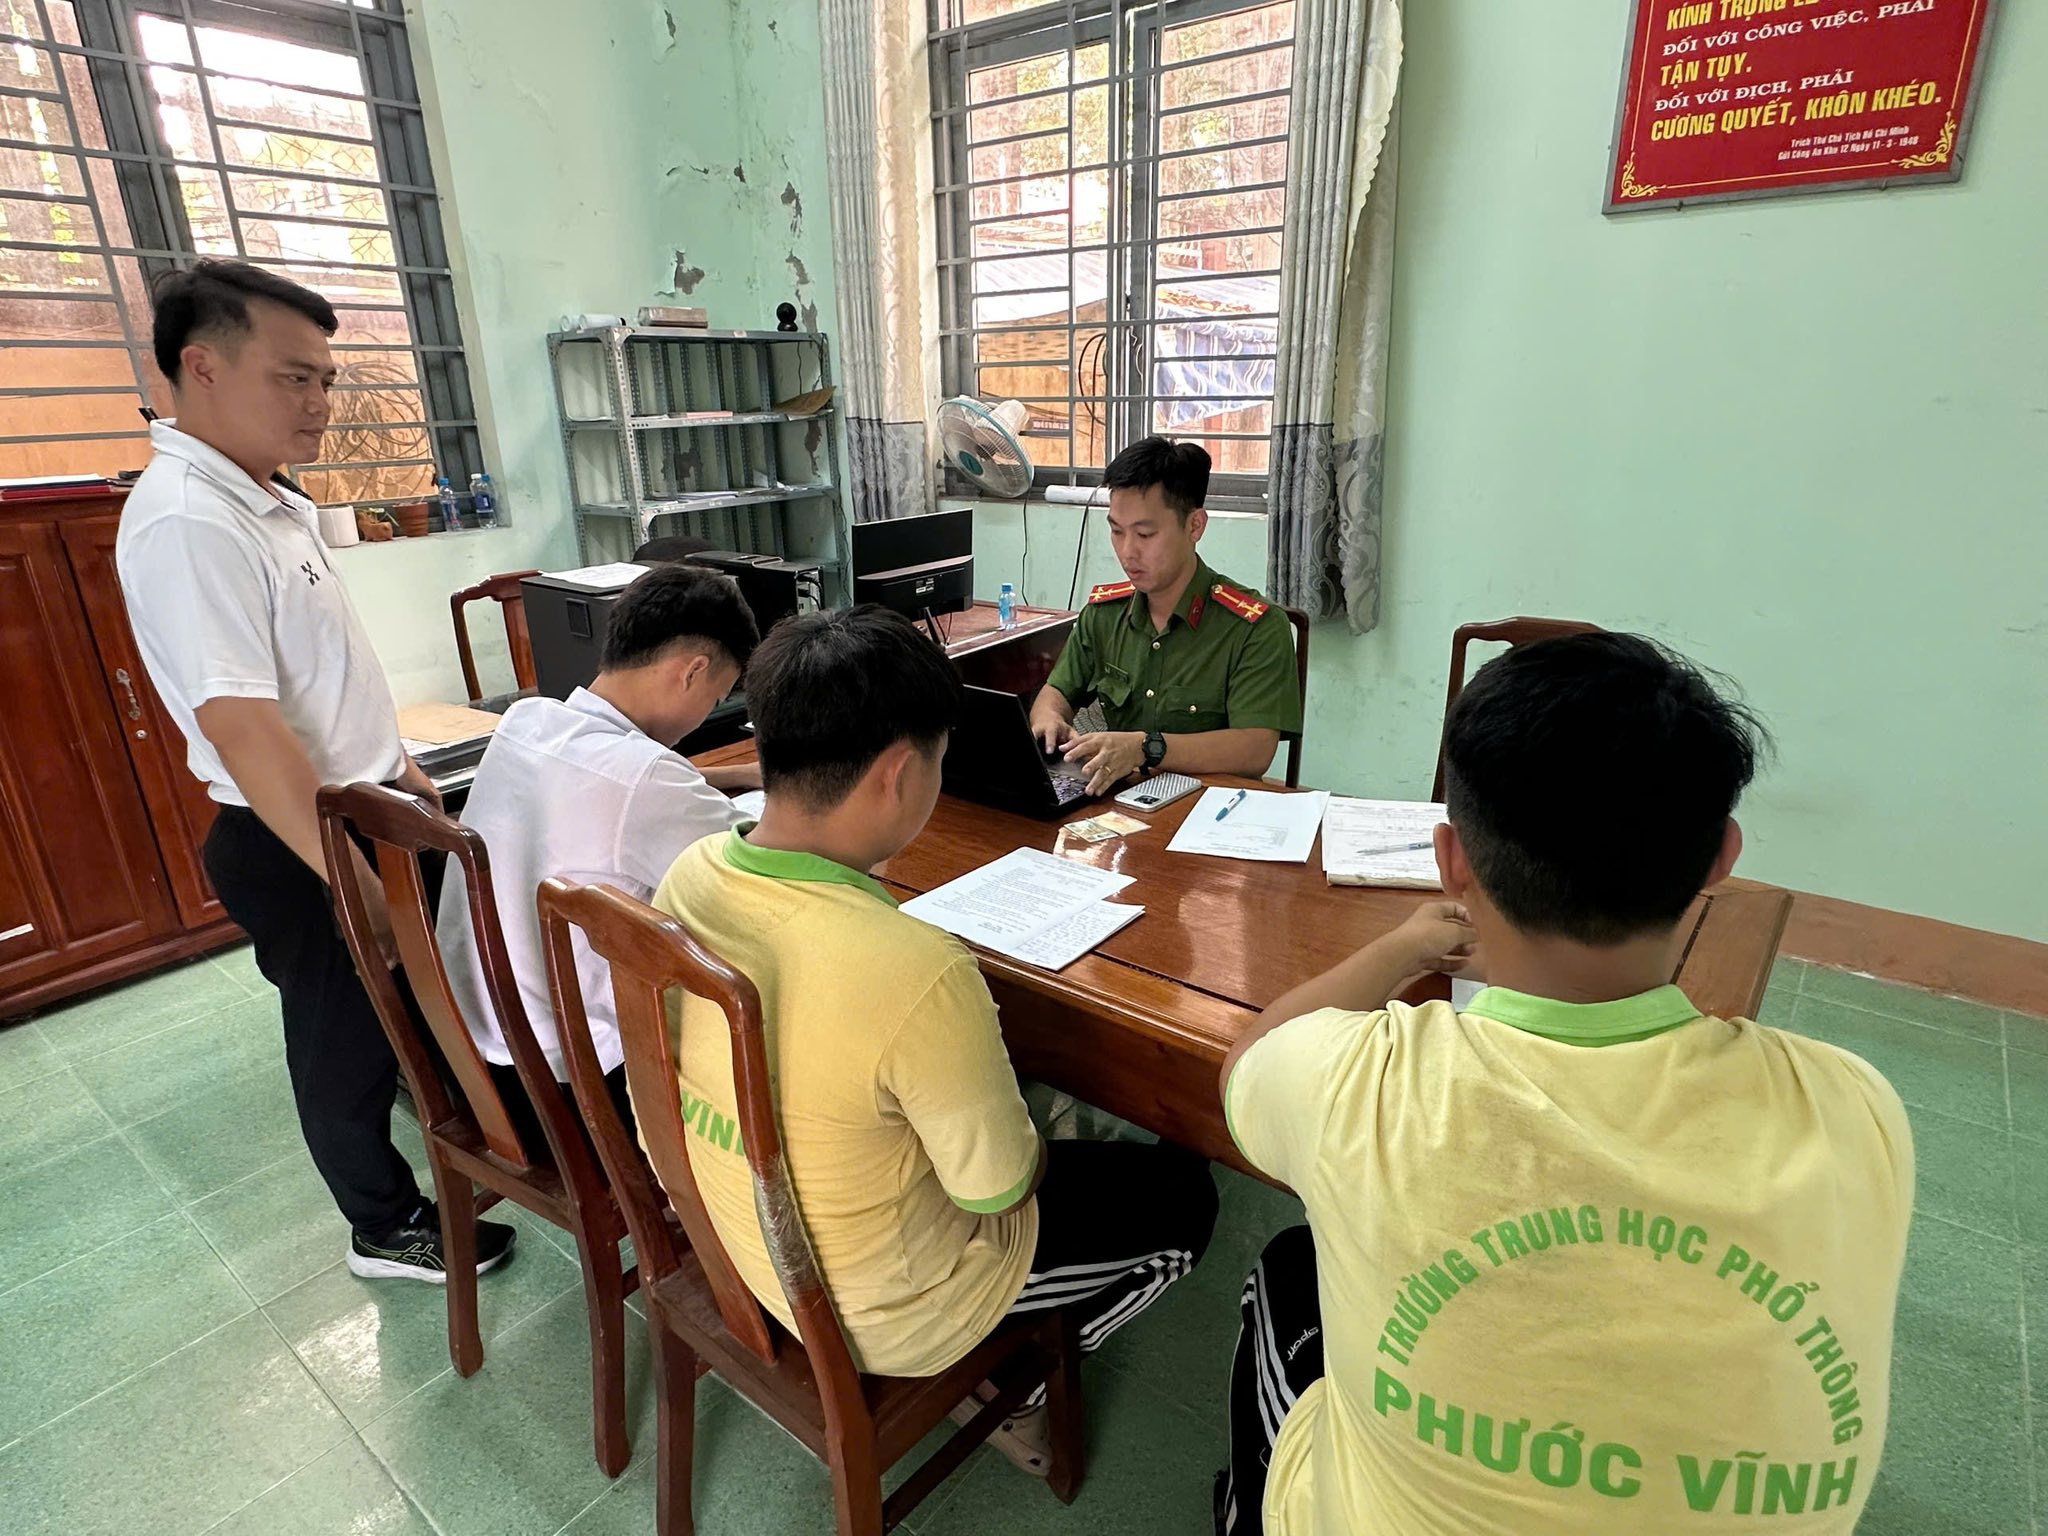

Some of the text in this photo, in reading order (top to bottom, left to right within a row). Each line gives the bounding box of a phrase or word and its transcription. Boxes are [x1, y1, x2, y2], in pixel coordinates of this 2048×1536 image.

[1666, 1, 1713, 31] KÍNH
[1662, 35, 1699, 57] ĐỐI
[1704, 31, 1739, 49] VỚI
[1744, 21, 1804, 42] CÔNG
[1654, 92, 1690, 112] ĐỐI
[1695, 88, 1730, 105] VỚI
[1799, 69, 1855, 90] PHẢI
[1660, 52, 1752, 90] TẬN TỤY.
[1650, 78, 1942, 142] CƯƠNG QUYẾT, KHÔN KHÉO.
[1899, 135, 1920, 147] 1948
[1377, 1205, 1864, 1446] TRƯỜNG TRUNG HỌC PHỔ THÔNG
[1374, 1366, 1858, 1515] PHƯỚC VĨNH
